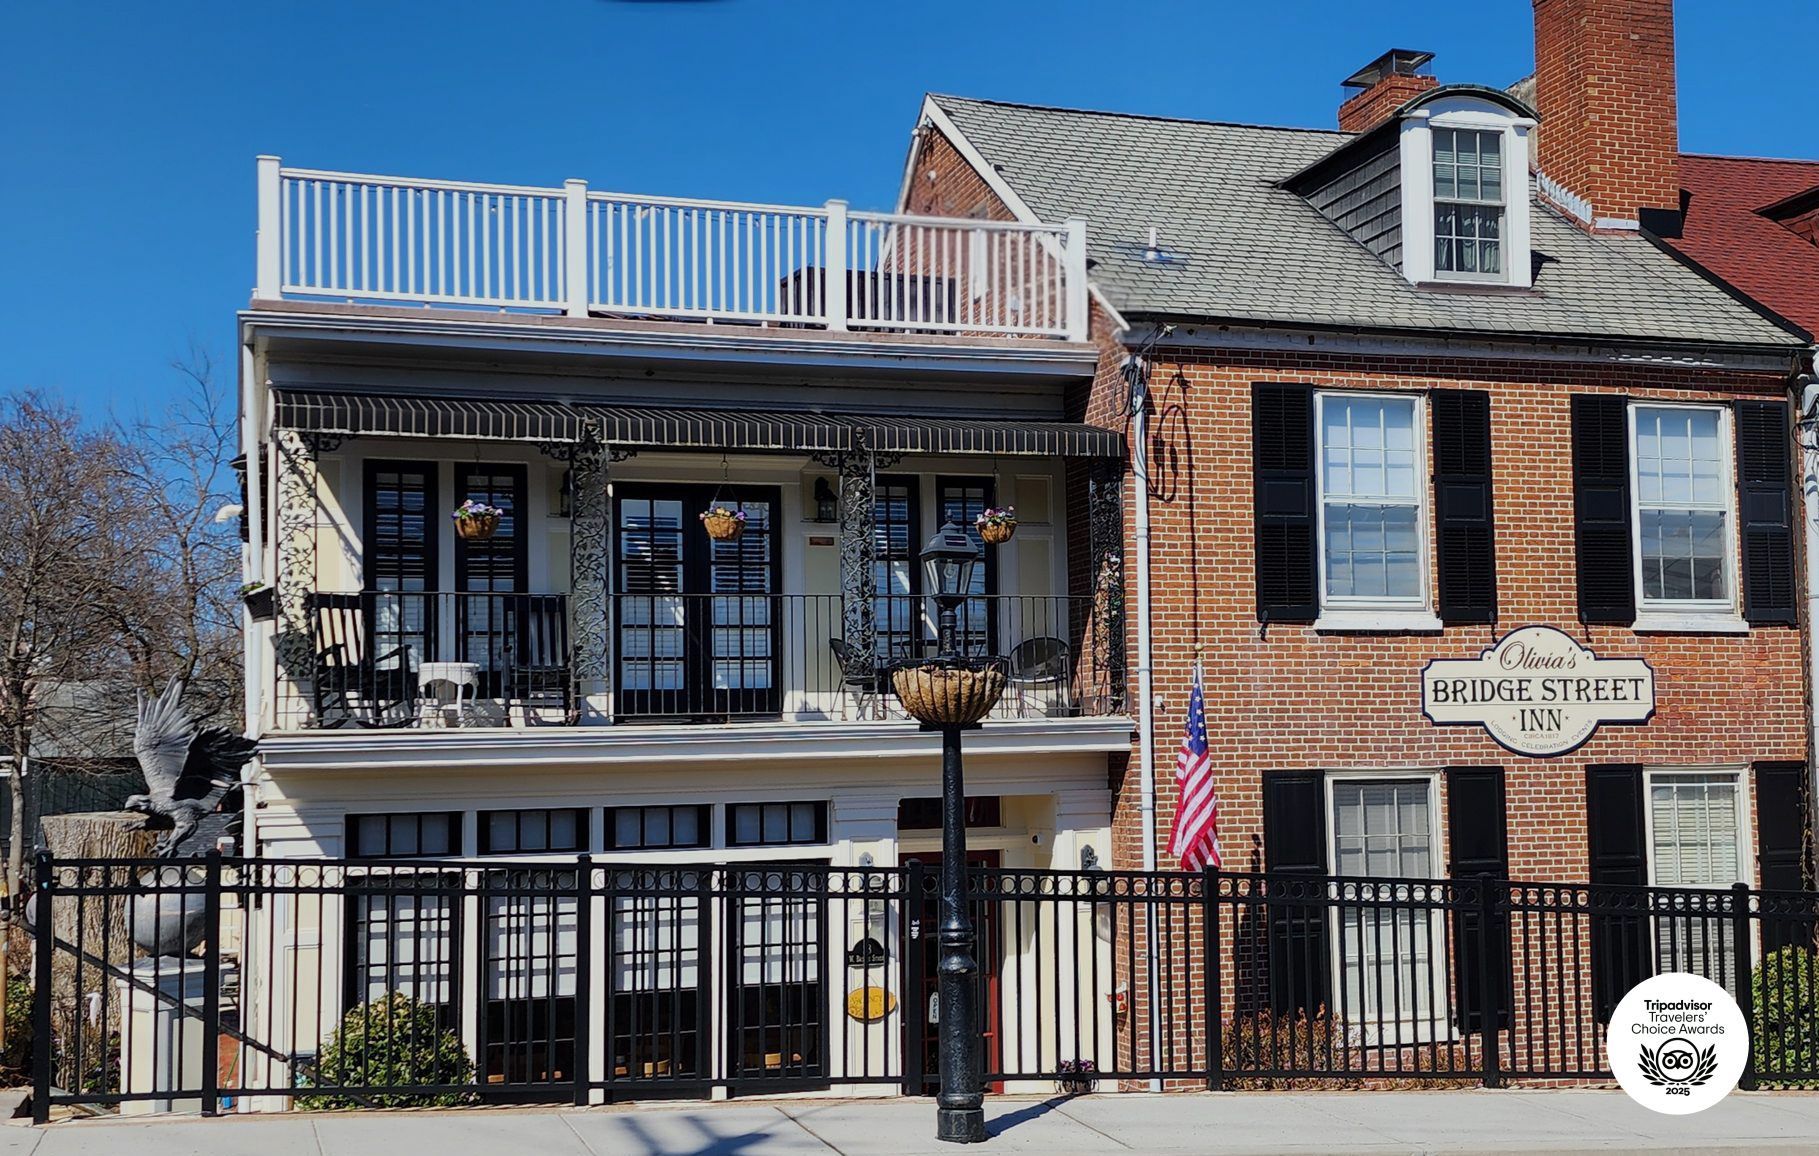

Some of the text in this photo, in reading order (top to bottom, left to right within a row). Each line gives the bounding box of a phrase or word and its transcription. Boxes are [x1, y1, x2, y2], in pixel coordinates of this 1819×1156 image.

[1499, 641, 1576, 670] Olivia's
[1432, 678, 1644, 704] BRIDGE STREET
[1520, 709, 1562, 731] INN
[1490, 719, 1594, 750] LODGING CELEBRATION EVENTS
